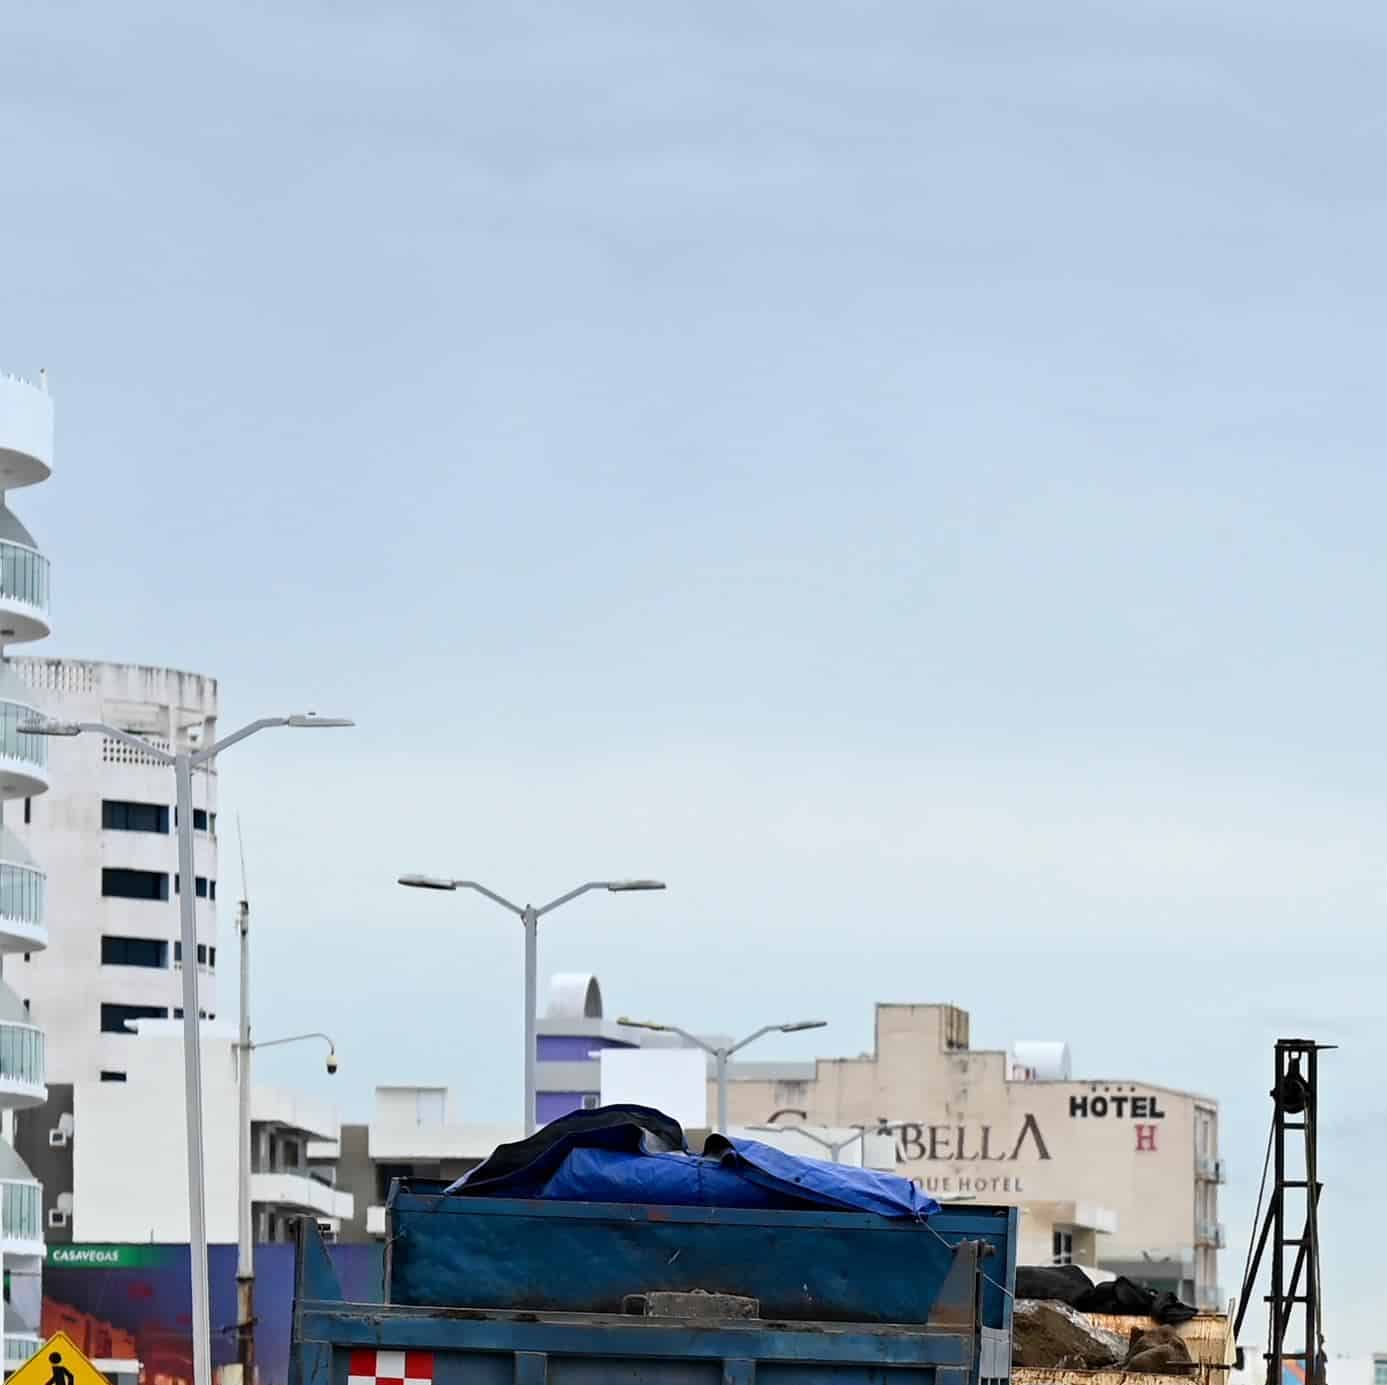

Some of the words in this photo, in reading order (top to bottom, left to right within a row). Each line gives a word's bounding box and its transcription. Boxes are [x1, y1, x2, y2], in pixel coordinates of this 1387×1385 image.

[1070, 1096, 1165, 1118] HOTEL
[1134, 1124, 1157, 1151] H
[959, 1176, 1023, 1192] HOTEL
